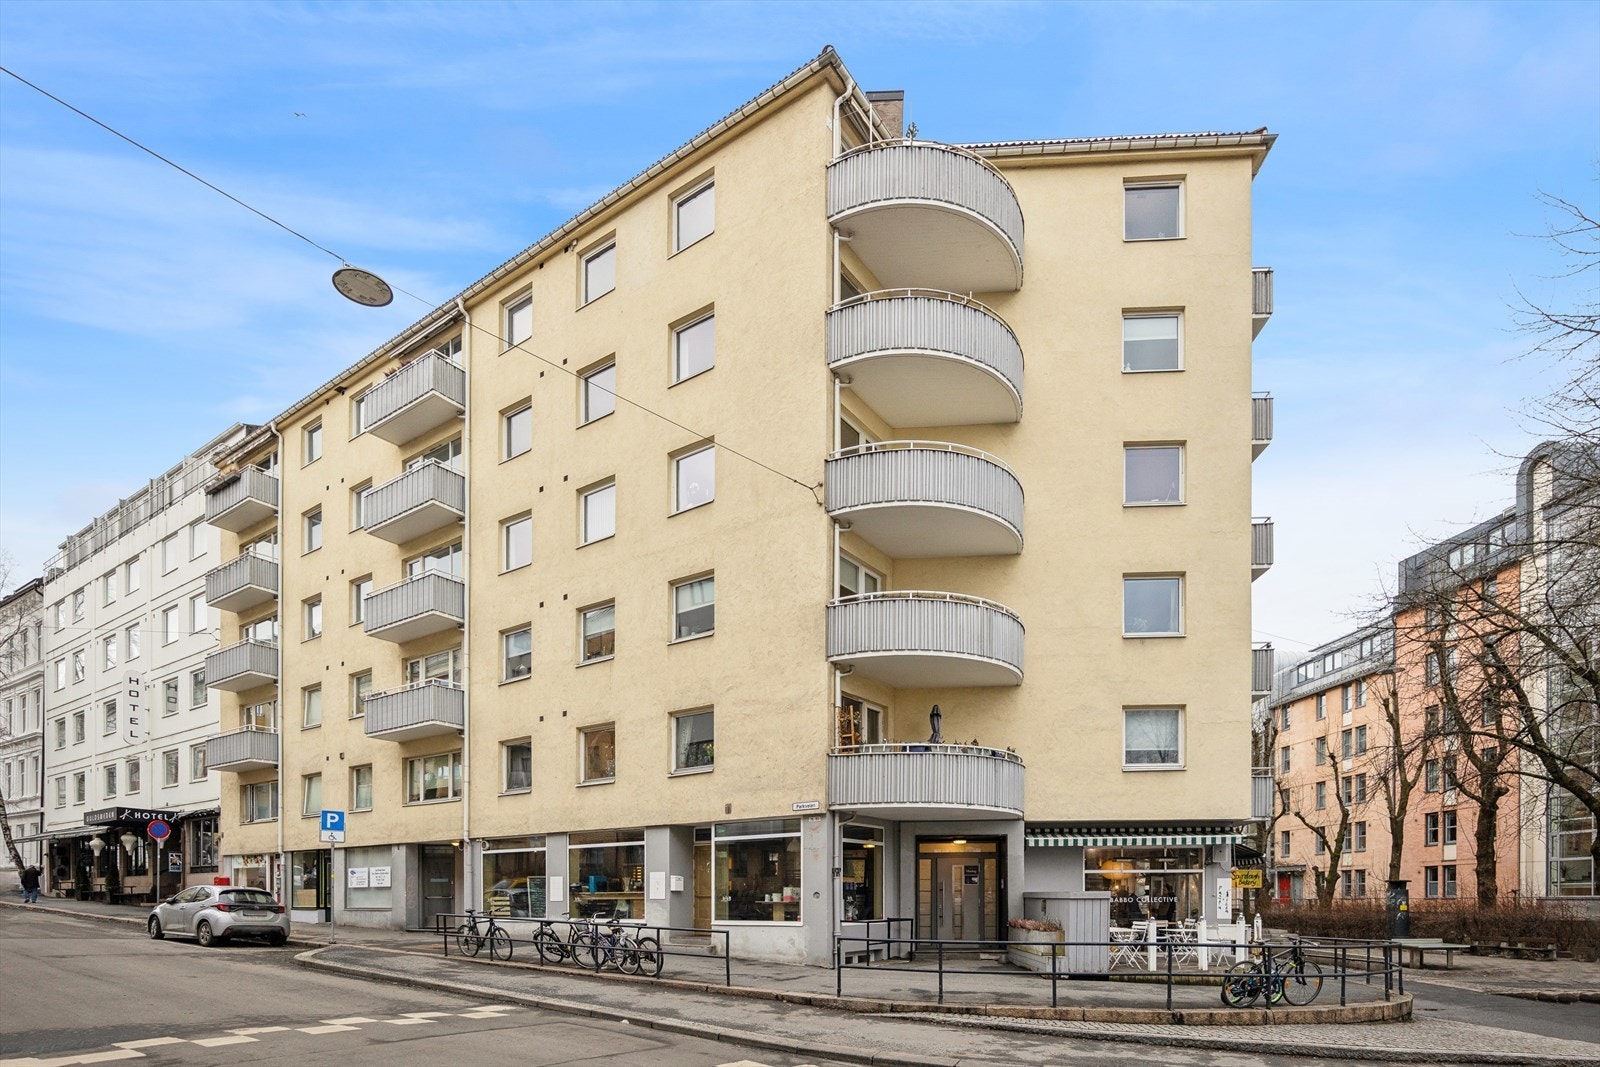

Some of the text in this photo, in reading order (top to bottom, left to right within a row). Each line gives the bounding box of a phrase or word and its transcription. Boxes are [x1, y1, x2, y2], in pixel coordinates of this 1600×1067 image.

[128, 676, 140, 739] HOTEL
[134, 812, 168, 820] HOTEL
[326, 812, 340, 828] P
